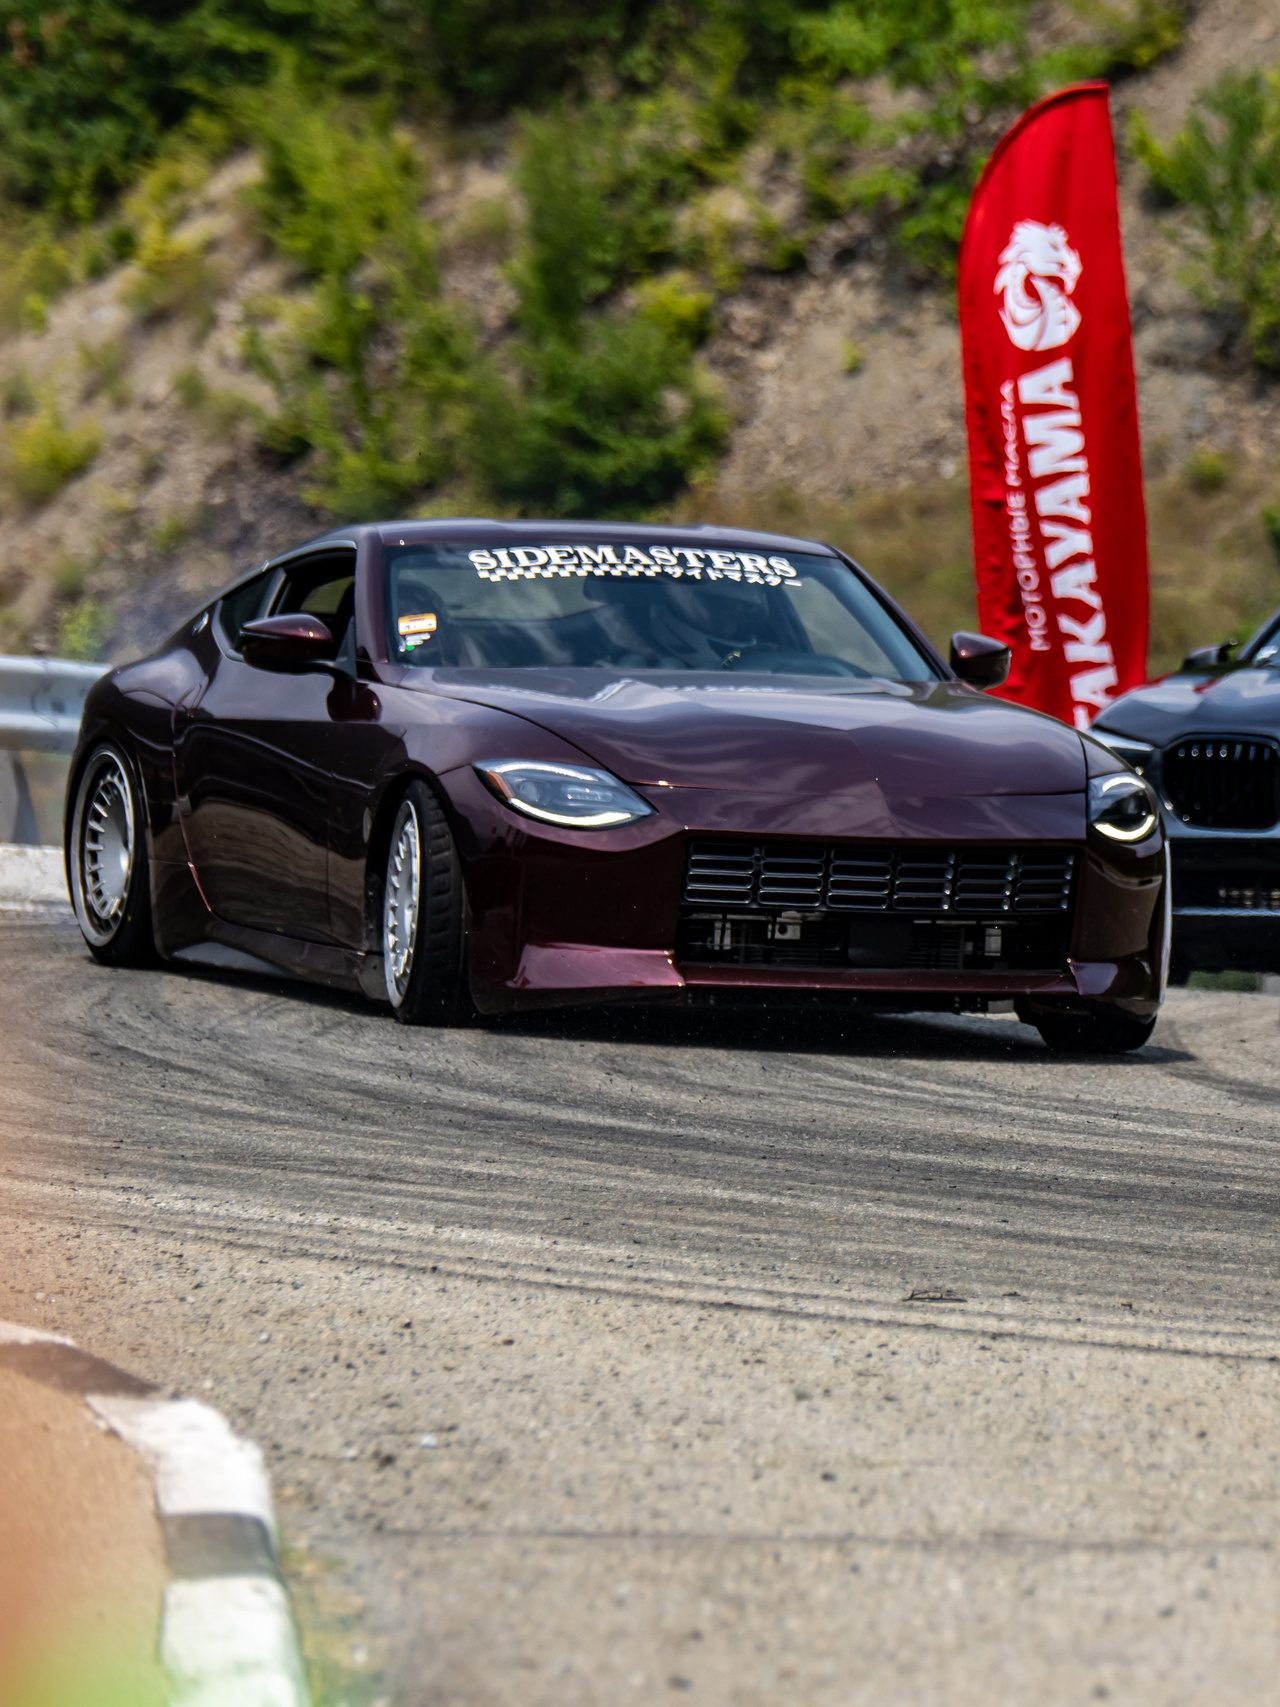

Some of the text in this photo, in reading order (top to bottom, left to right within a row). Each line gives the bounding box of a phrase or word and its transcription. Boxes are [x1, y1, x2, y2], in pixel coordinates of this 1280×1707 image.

[467, 545, 797, 577] SIDEMASTERS
[1000, 379, 1050, 651] МОТОРНЫЕ МАСЛА
